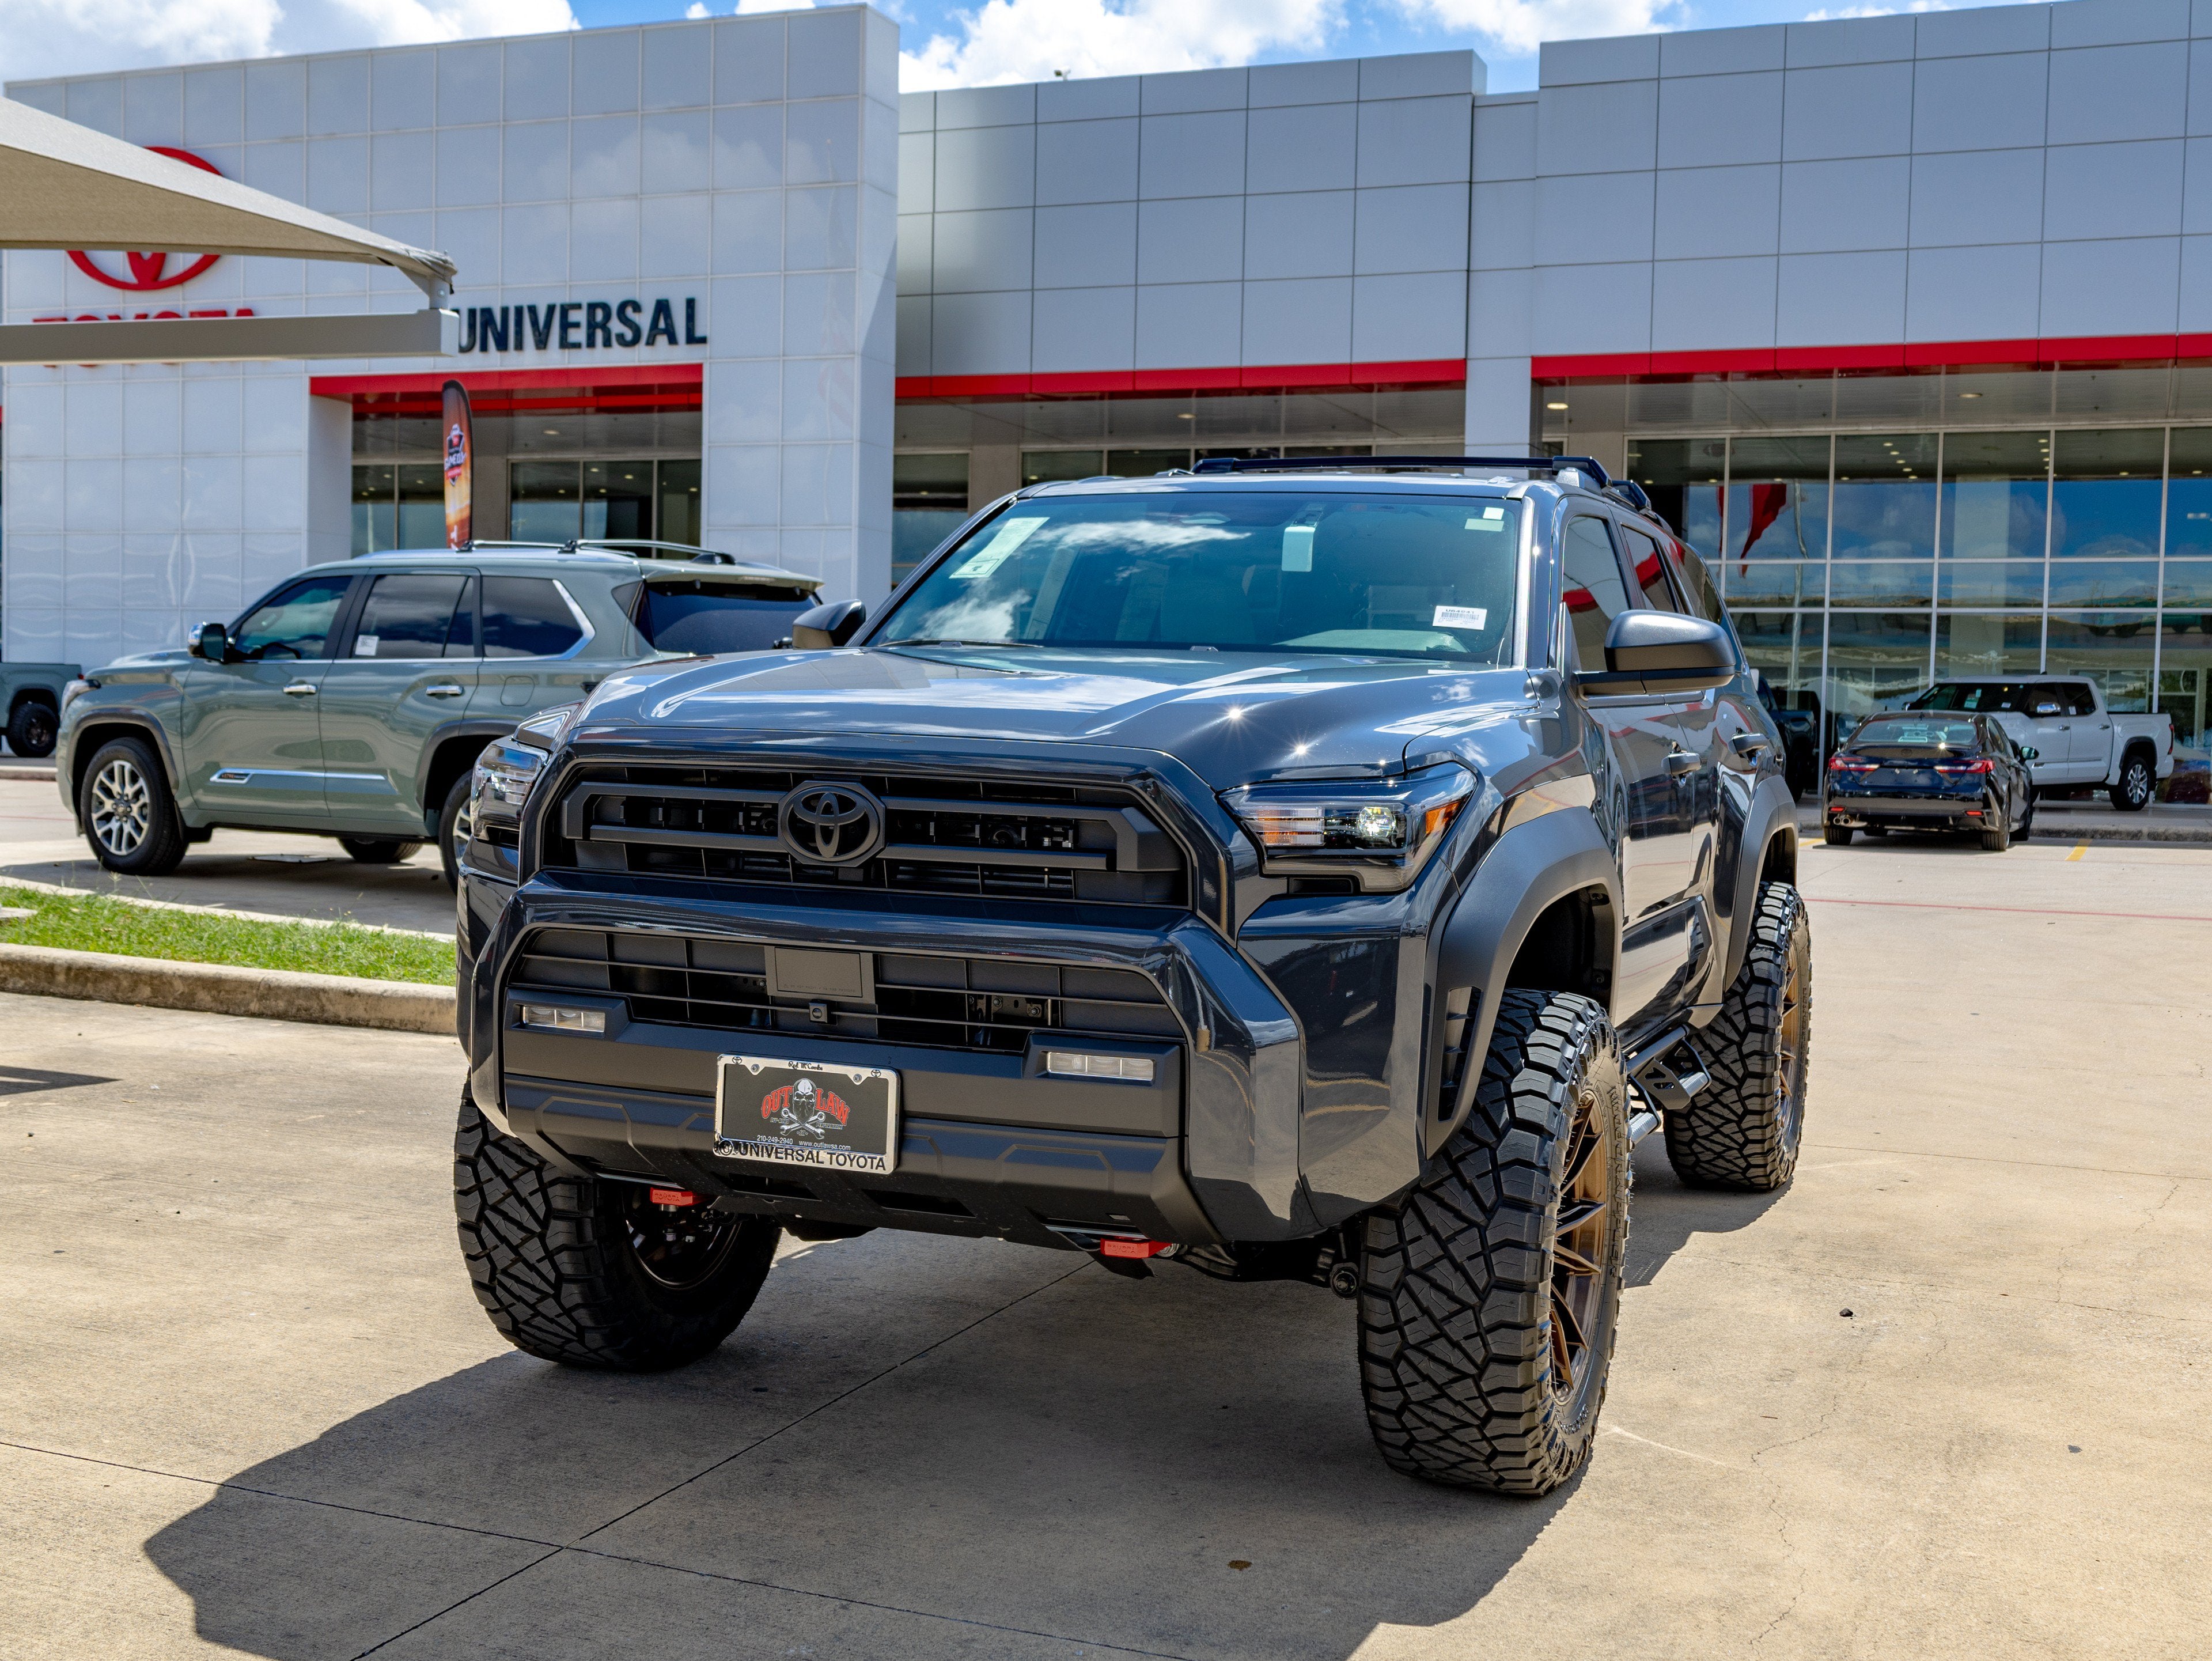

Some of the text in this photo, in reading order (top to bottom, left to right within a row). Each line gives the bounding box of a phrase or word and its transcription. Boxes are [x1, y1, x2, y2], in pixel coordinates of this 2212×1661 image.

[451, 297, 707, 353] UNIVERSAL
[788, 1061, 799, 1070] Red
[757, 1134, 851, 1151] 210-249-2940 www.outlawsa.com
[738, 1141, 887, 1171] UNIVERSAL TOYOTA
